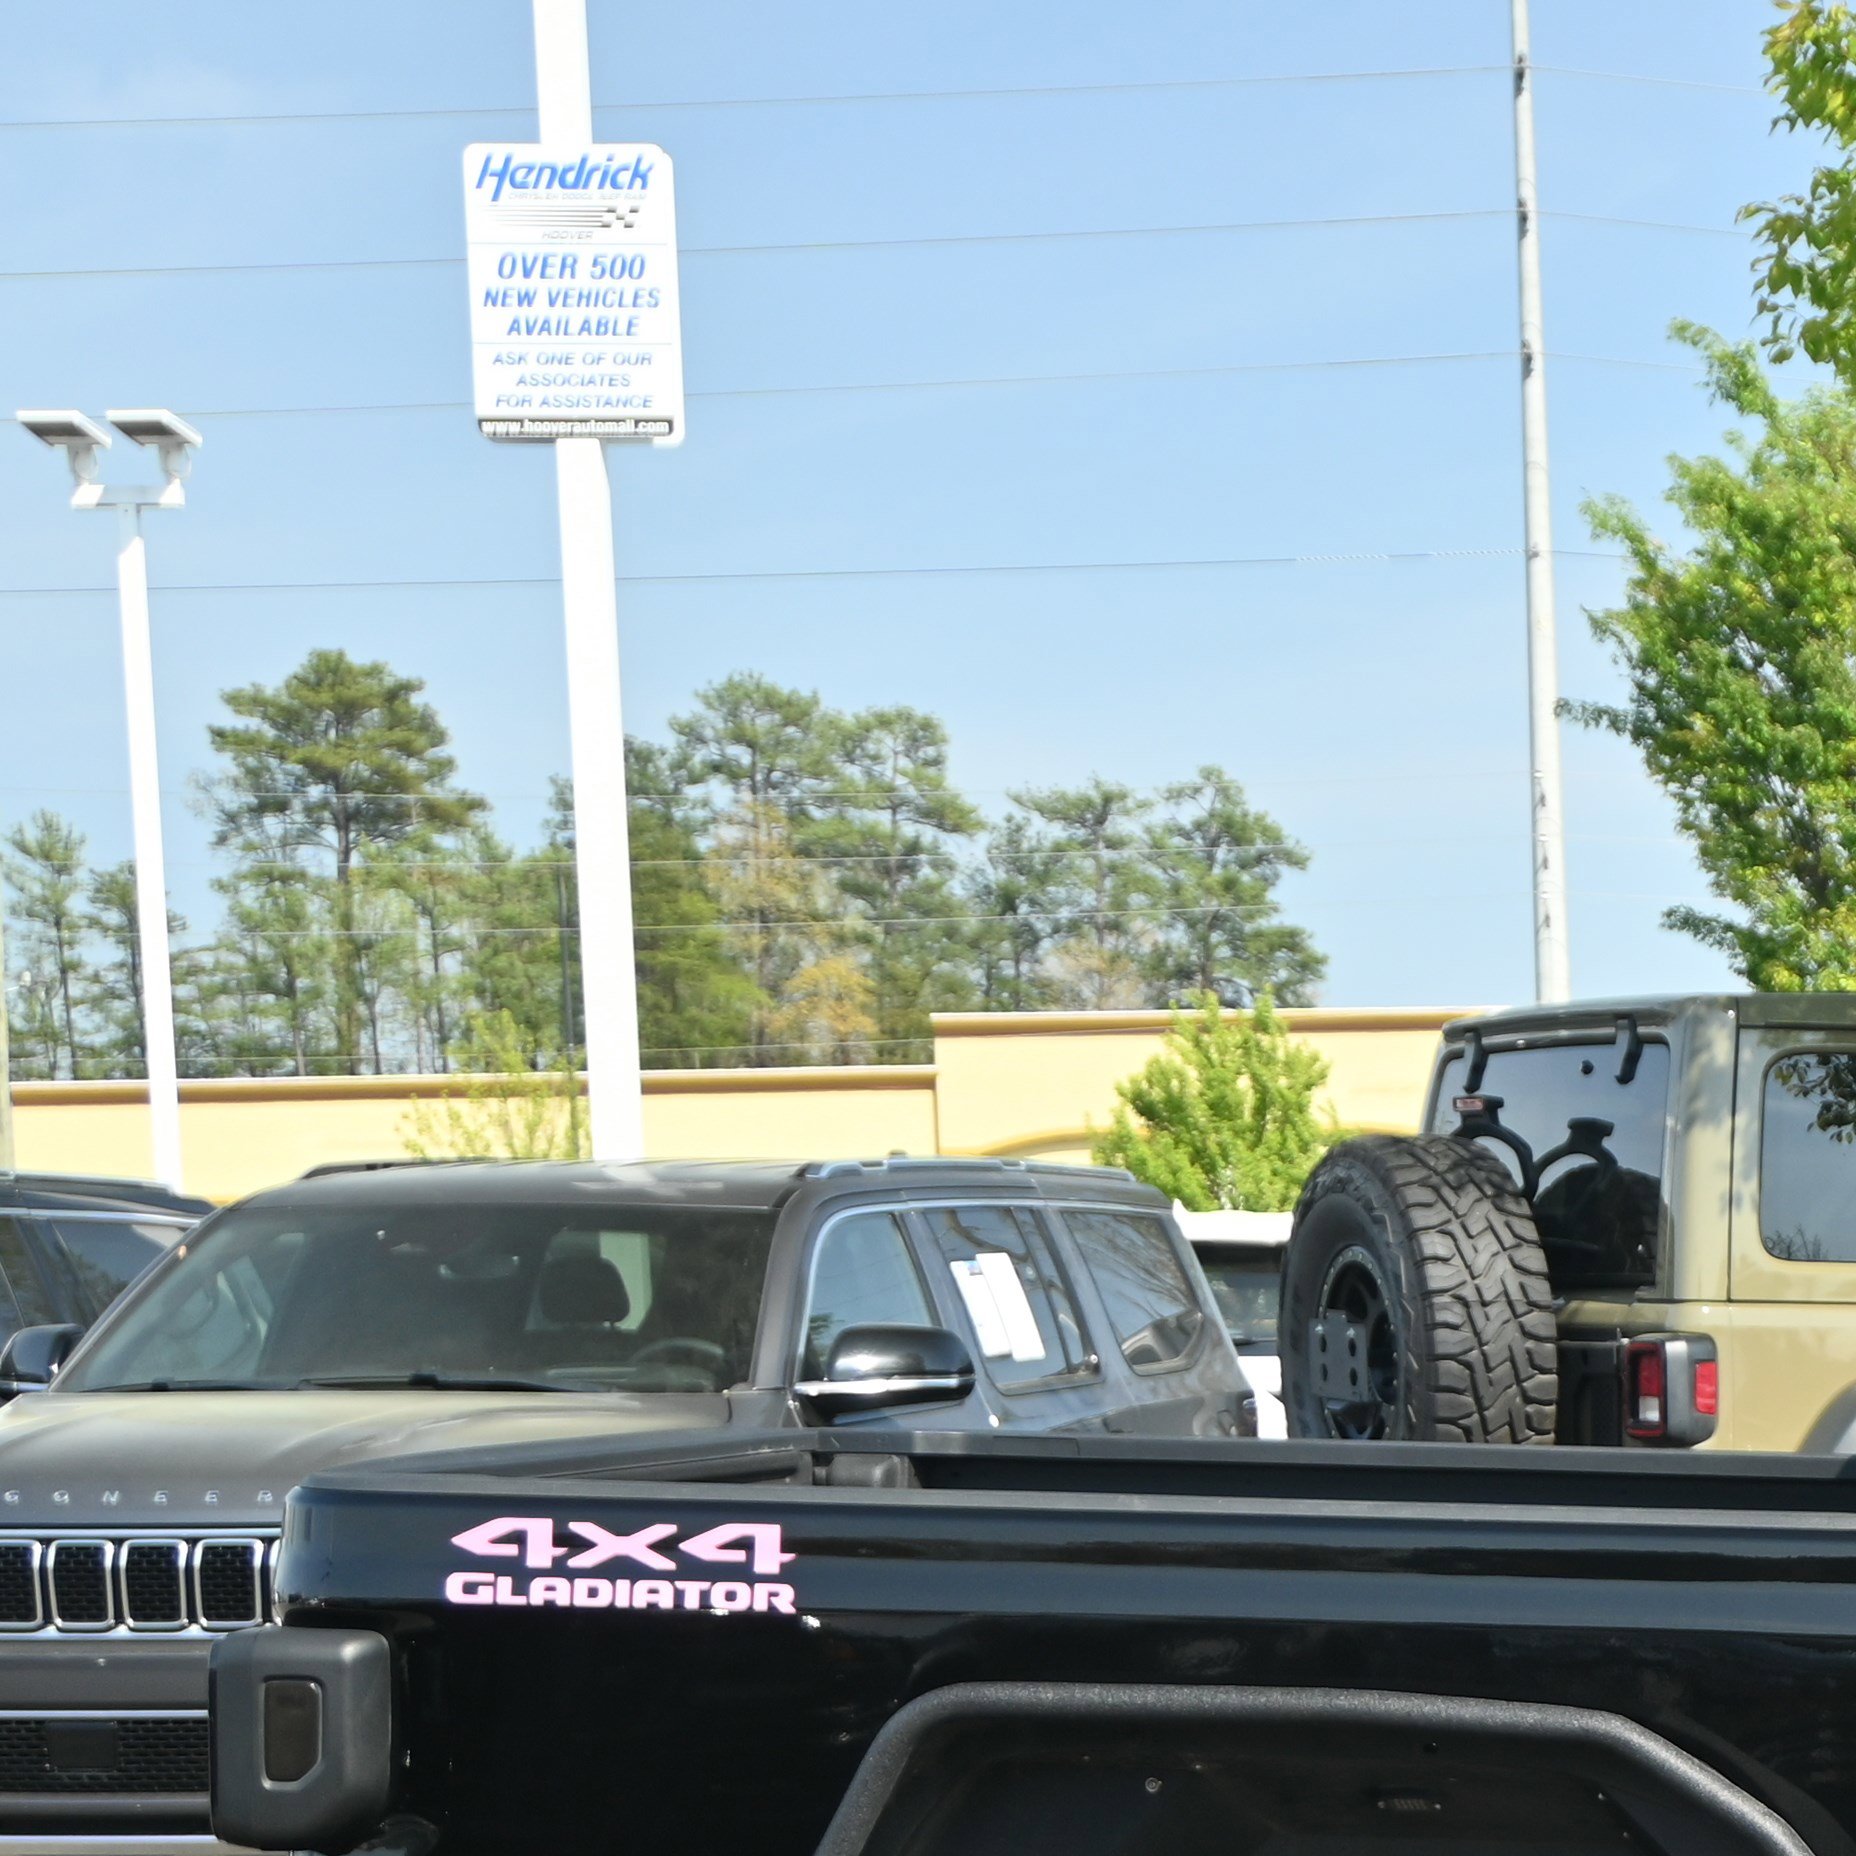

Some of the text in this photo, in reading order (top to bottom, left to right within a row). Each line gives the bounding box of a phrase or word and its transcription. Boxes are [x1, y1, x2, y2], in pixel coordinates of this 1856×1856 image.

[475, 151, 655, 202] Hendrick
[541, 230, 595, 240] HOOVER
[497, 252, 646, 280] OVER 500
[483, 287, 660, 309] NEW VEHICLES
[506, 315, 640, 337] AVAILABLE
[492, 351, 652, 366] ASK ONE OF OUR
[515, 373, 631, 387] ASSOCIATES
[495, 393, 654, 409] FOR ASSISTANCE
[481, 419, 670, 436] www.hooverautomall.com
[445, 1571, 798, 1614] GLADIATOR
